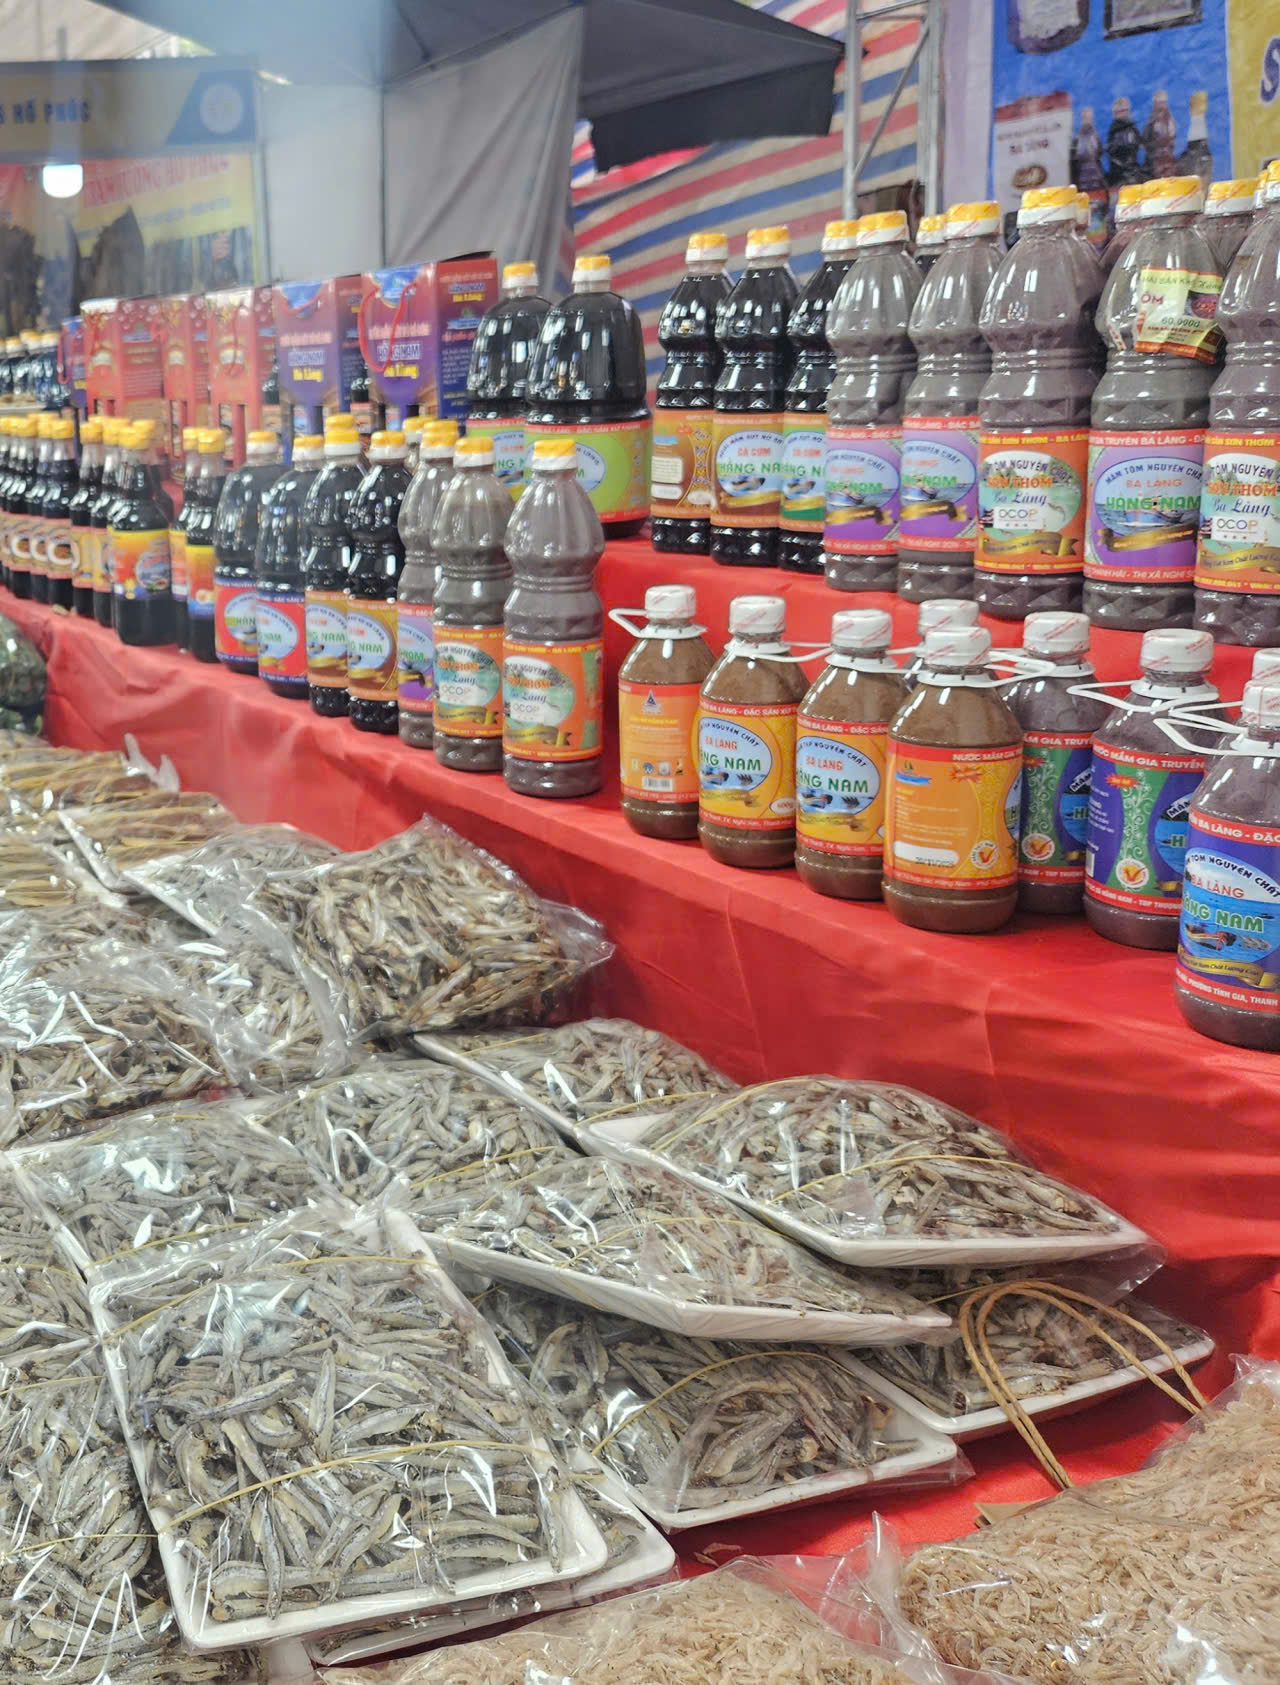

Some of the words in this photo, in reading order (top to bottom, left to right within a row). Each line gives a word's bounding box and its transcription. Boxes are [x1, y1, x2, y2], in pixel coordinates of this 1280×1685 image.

[761, 462, 784, 473] NA
[999, 508, 1039, 519] OCOP
[1217, 518, 1258, 530] OCOP
[1041, 737, 1062, 746] GIA
[1065, 737, 1092, 746] TRUY
[724, 756, 761, 771] NAM
[1136, 756, 1159, 767] GIA
[828, 777, 869, 793] NAM
[1211, 821, 1244, 839] LÀNG
[1206, 878, 1245, 898] LÀNG
[1216, 909, 1264, 934] NAM
